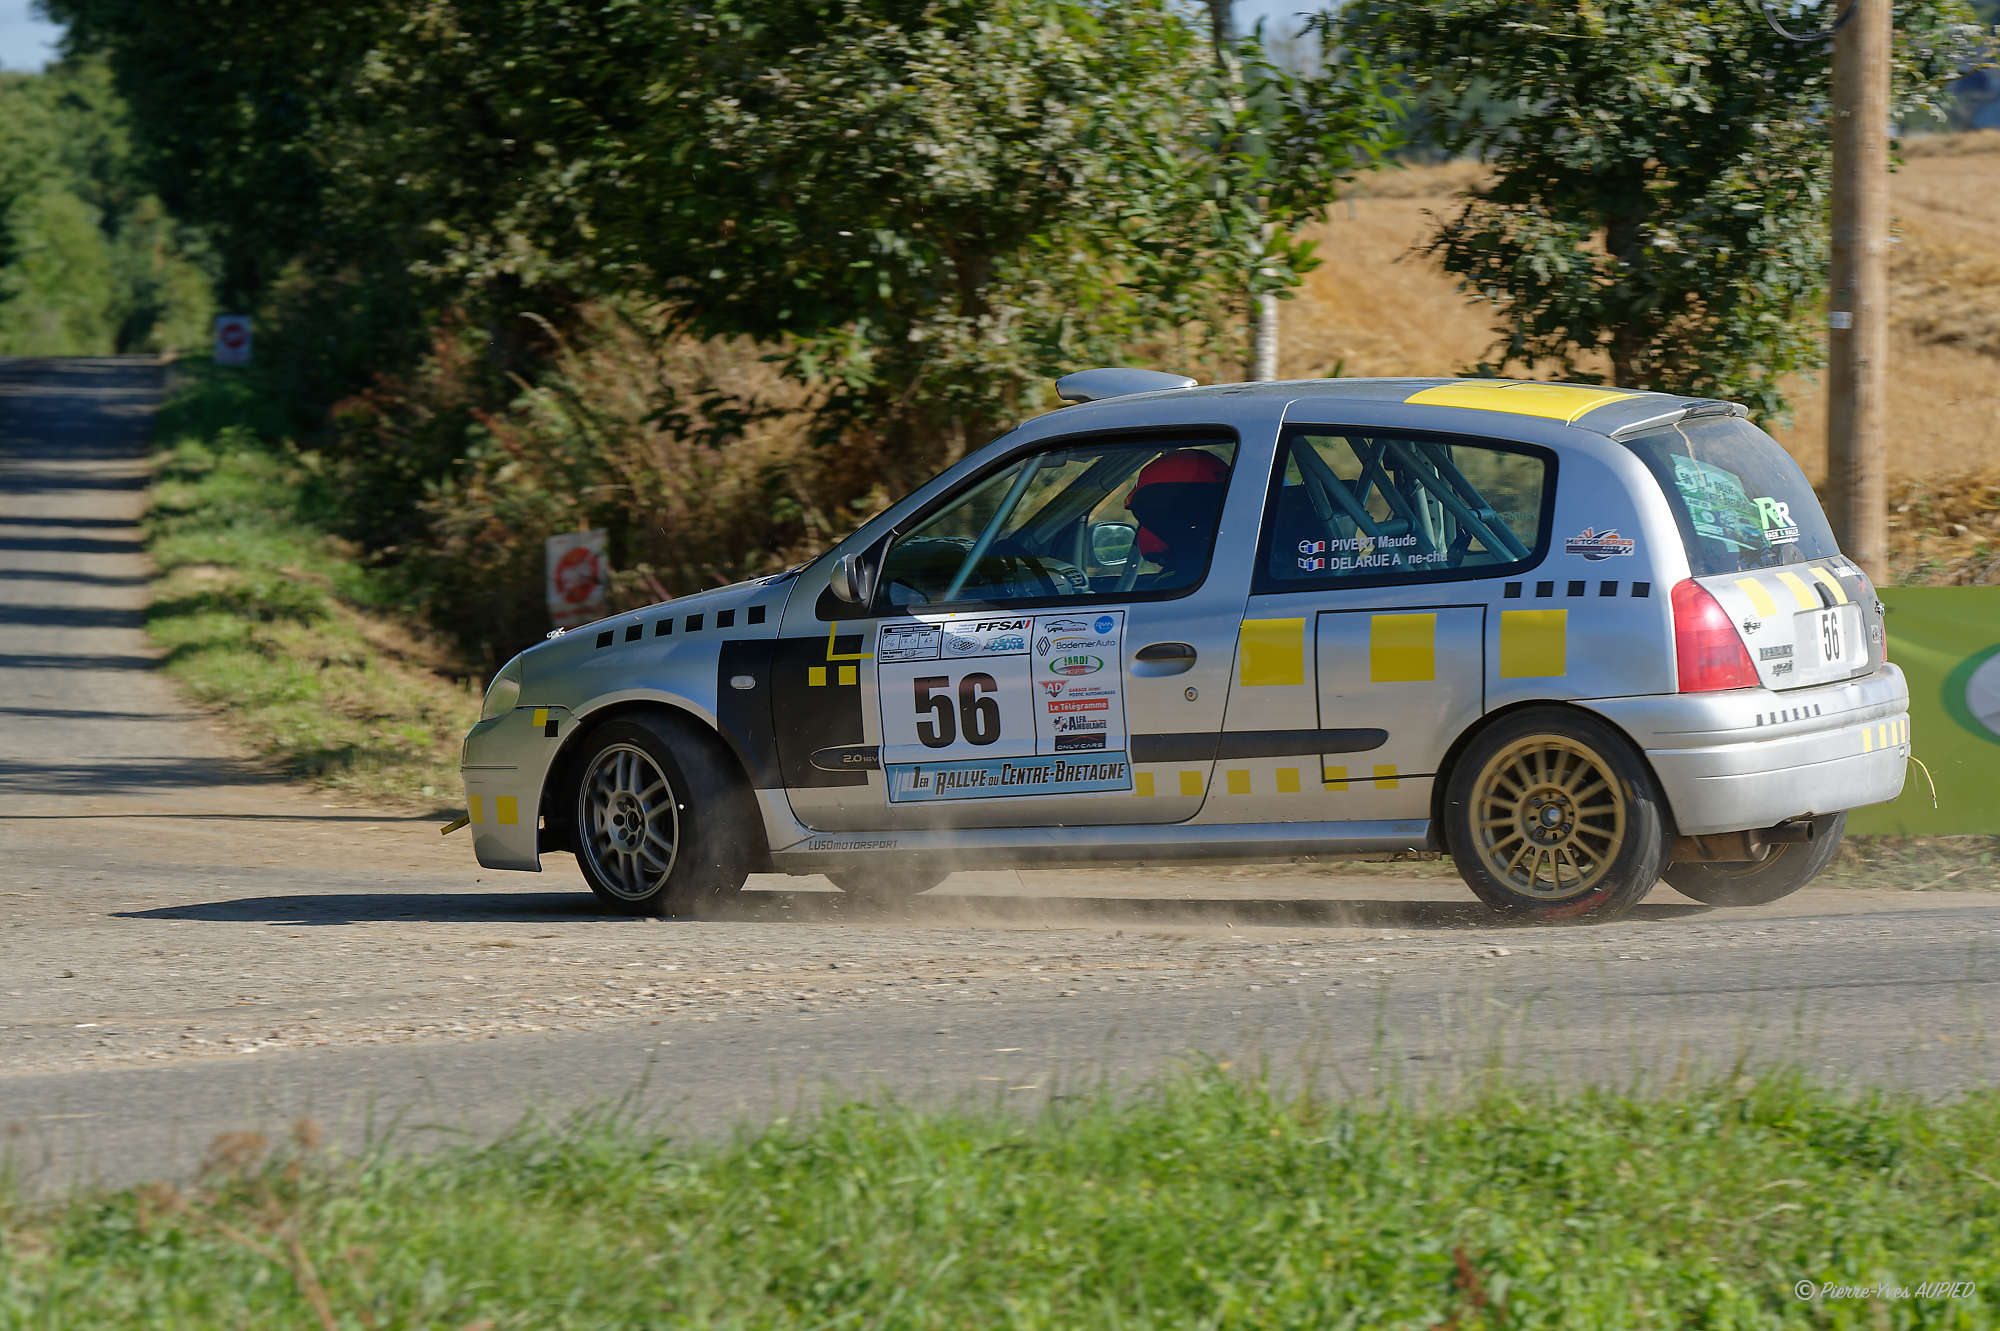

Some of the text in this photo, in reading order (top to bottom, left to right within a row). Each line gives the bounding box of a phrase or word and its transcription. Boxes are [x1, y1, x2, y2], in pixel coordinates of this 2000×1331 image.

[1331, 534, 1417, 551] PIVERT Maude
[1331, 554, 1389, 570] DELARUE
[975, 620, 1023, 632] FFSA
[1822, 612, 1840, 661] 56
[1047, 683, 1064, 693] AD
[913, 671, 1001, 749] 56
[843, 754, 863, 763] 2.0
[935, 769, 988, 796] RALLYE
[988, 775, 999, 786] DU
[1001, 760, 1126, 786] CENTRE-BRETAGNE
